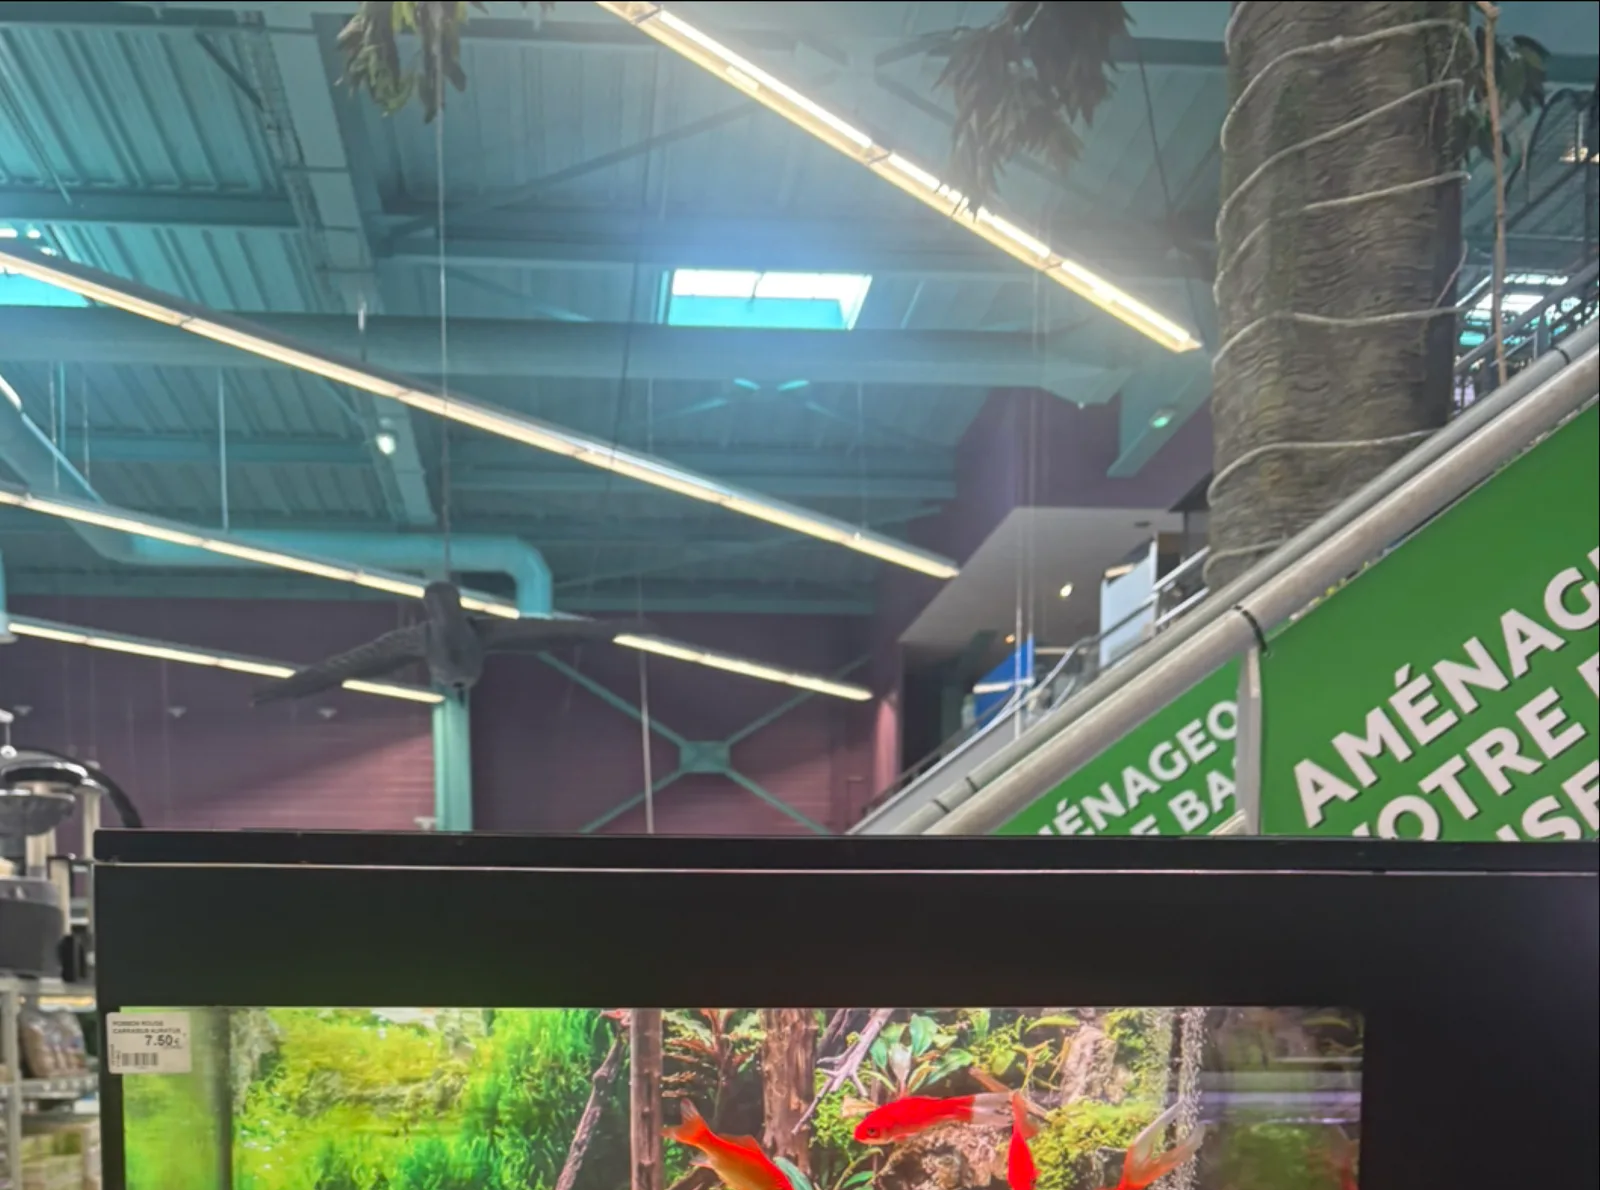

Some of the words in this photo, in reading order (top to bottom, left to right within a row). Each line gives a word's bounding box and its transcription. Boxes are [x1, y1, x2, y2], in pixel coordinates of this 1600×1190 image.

[1294, 547, 1599, 829] AMÉNAG
[1038, 701, 1237, 834] ÉNAGEO
[1168, 756, 1237, 832] BA
[1352, 686, 1587, 839] OTRE
